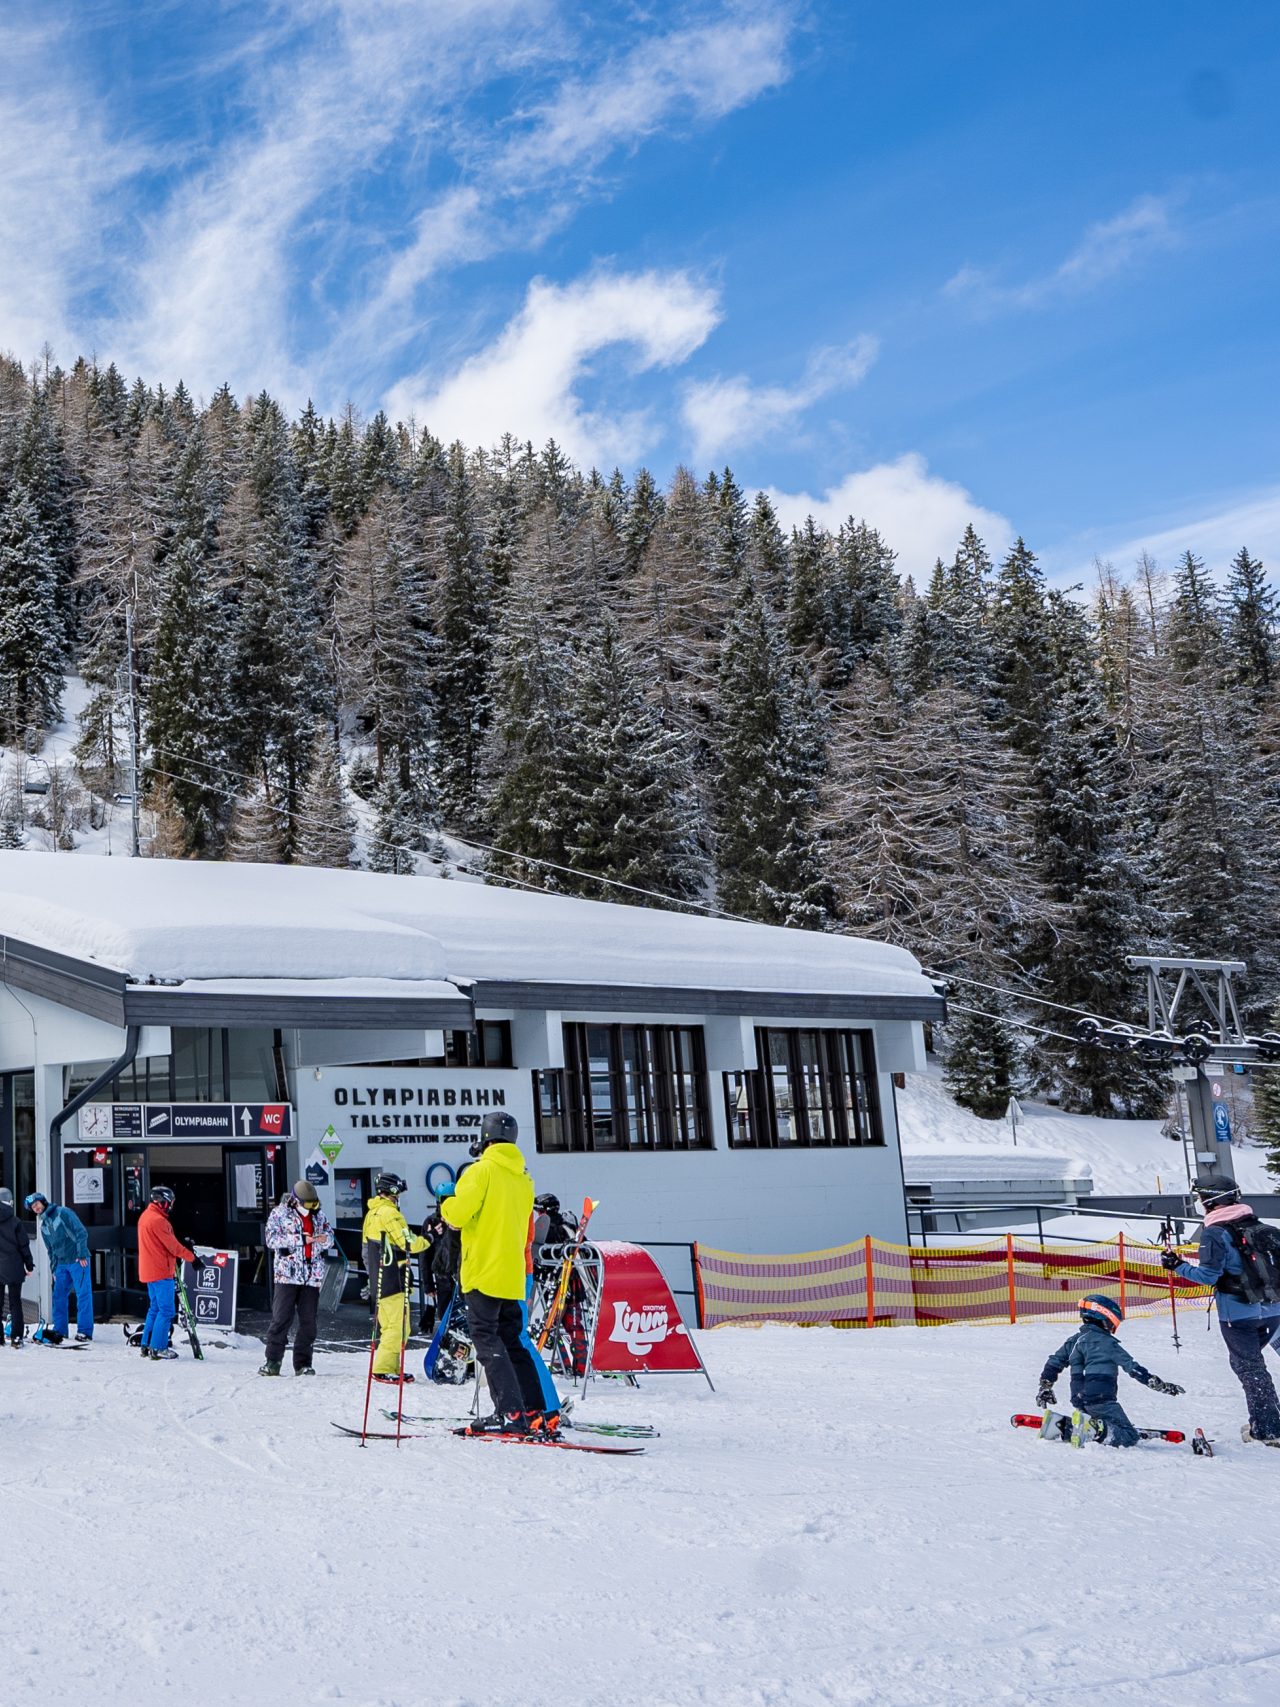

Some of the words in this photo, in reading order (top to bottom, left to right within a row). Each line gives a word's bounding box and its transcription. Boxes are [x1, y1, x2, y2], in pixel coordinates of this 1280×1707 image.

[334, 1087, 506, 1106] OLYMPIABAHN
[174, 1116, 229, 1127] OLYMPIABAHN
[264, 1114, 281, 1125] WC
[350, 1114, 451, 1128] TALSTATION
[367, 1134, 439, 1144] BERGSTATION
[443, 1134, 469, 1143] 2333
